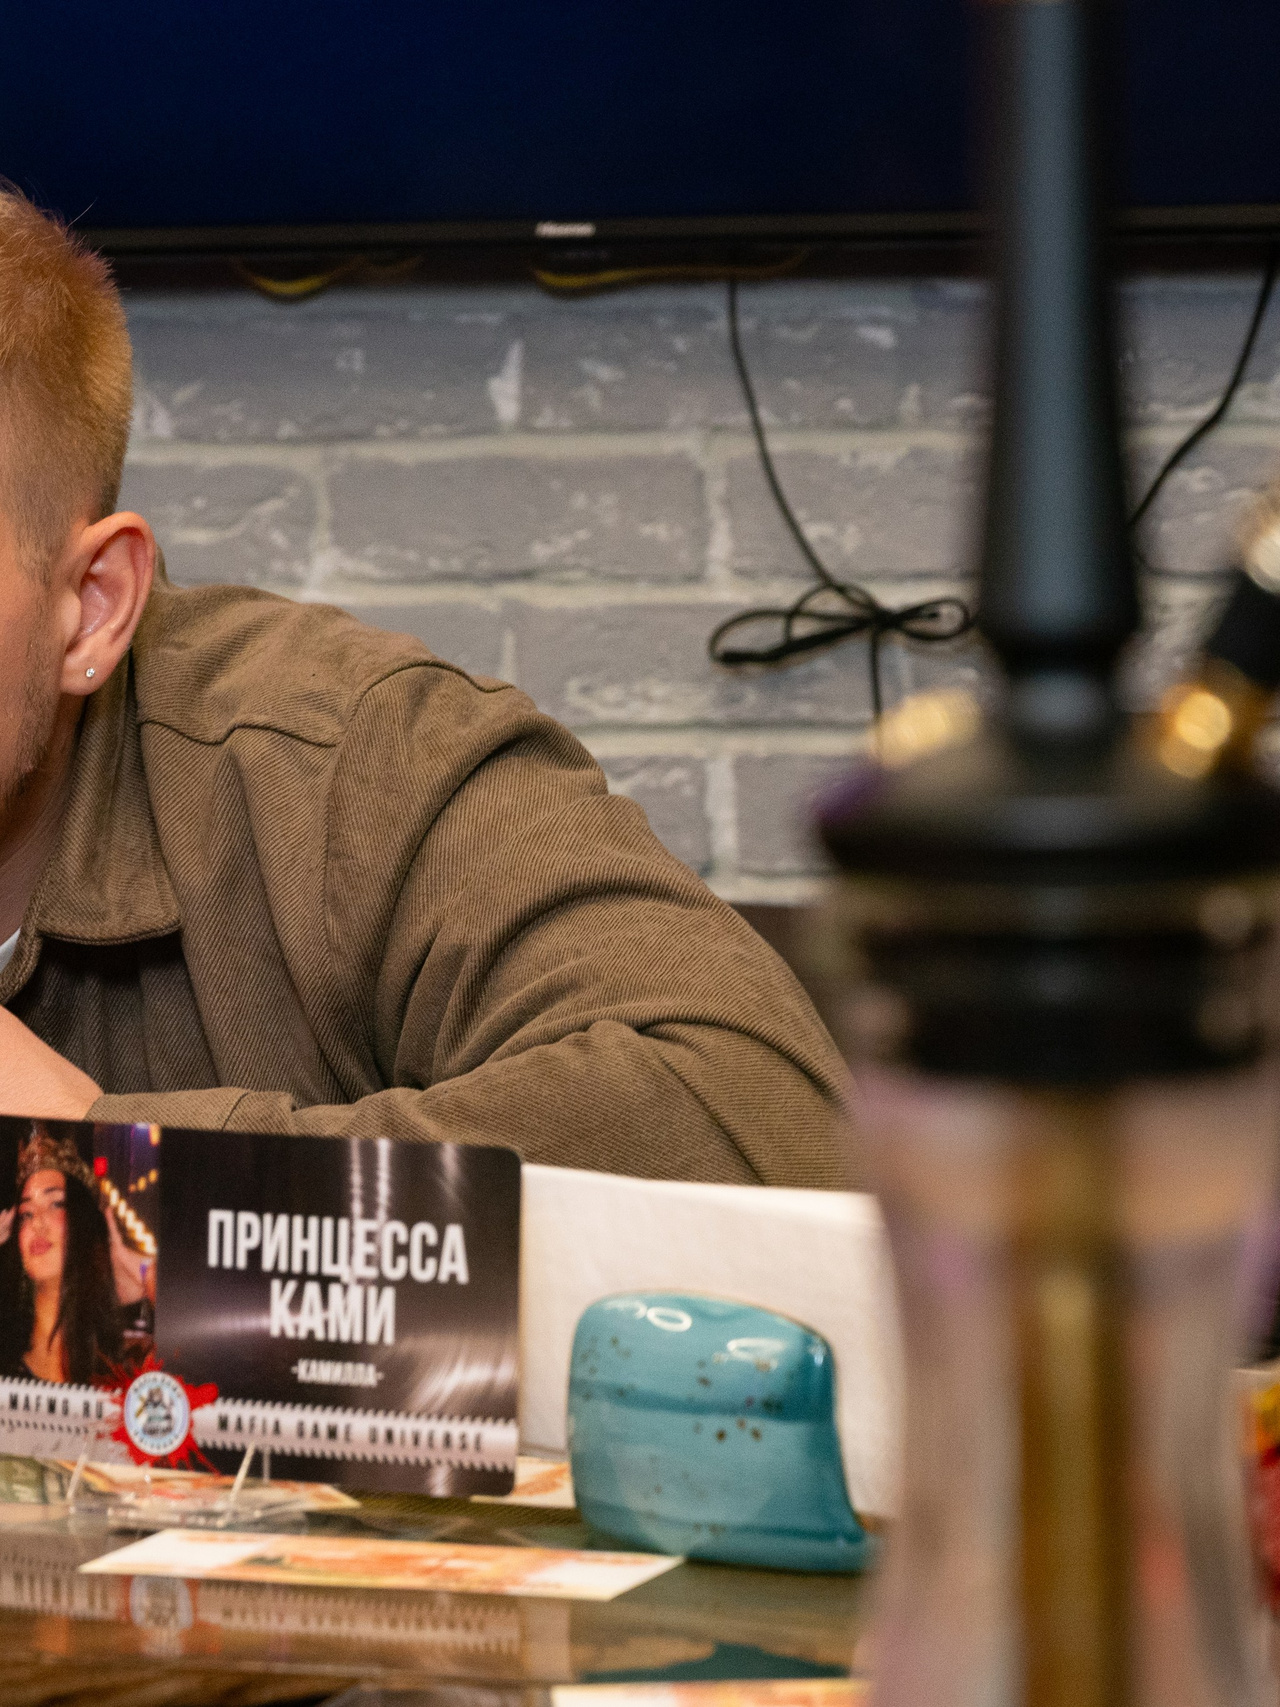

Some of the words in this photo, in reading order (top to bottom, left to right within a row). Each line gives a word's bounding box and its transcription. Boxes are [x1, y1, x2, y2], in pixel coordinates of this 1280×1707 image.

[207, 1208, 470, 1285] ПРИНЦЕССА
[269, 1277, 398, 1347] КАМИ
[217, 1413, 281, 1438] MAFIA
[296, 1418, 353, 1444] GAME
[369, 1425, 483, 1452] UNIVERSE
